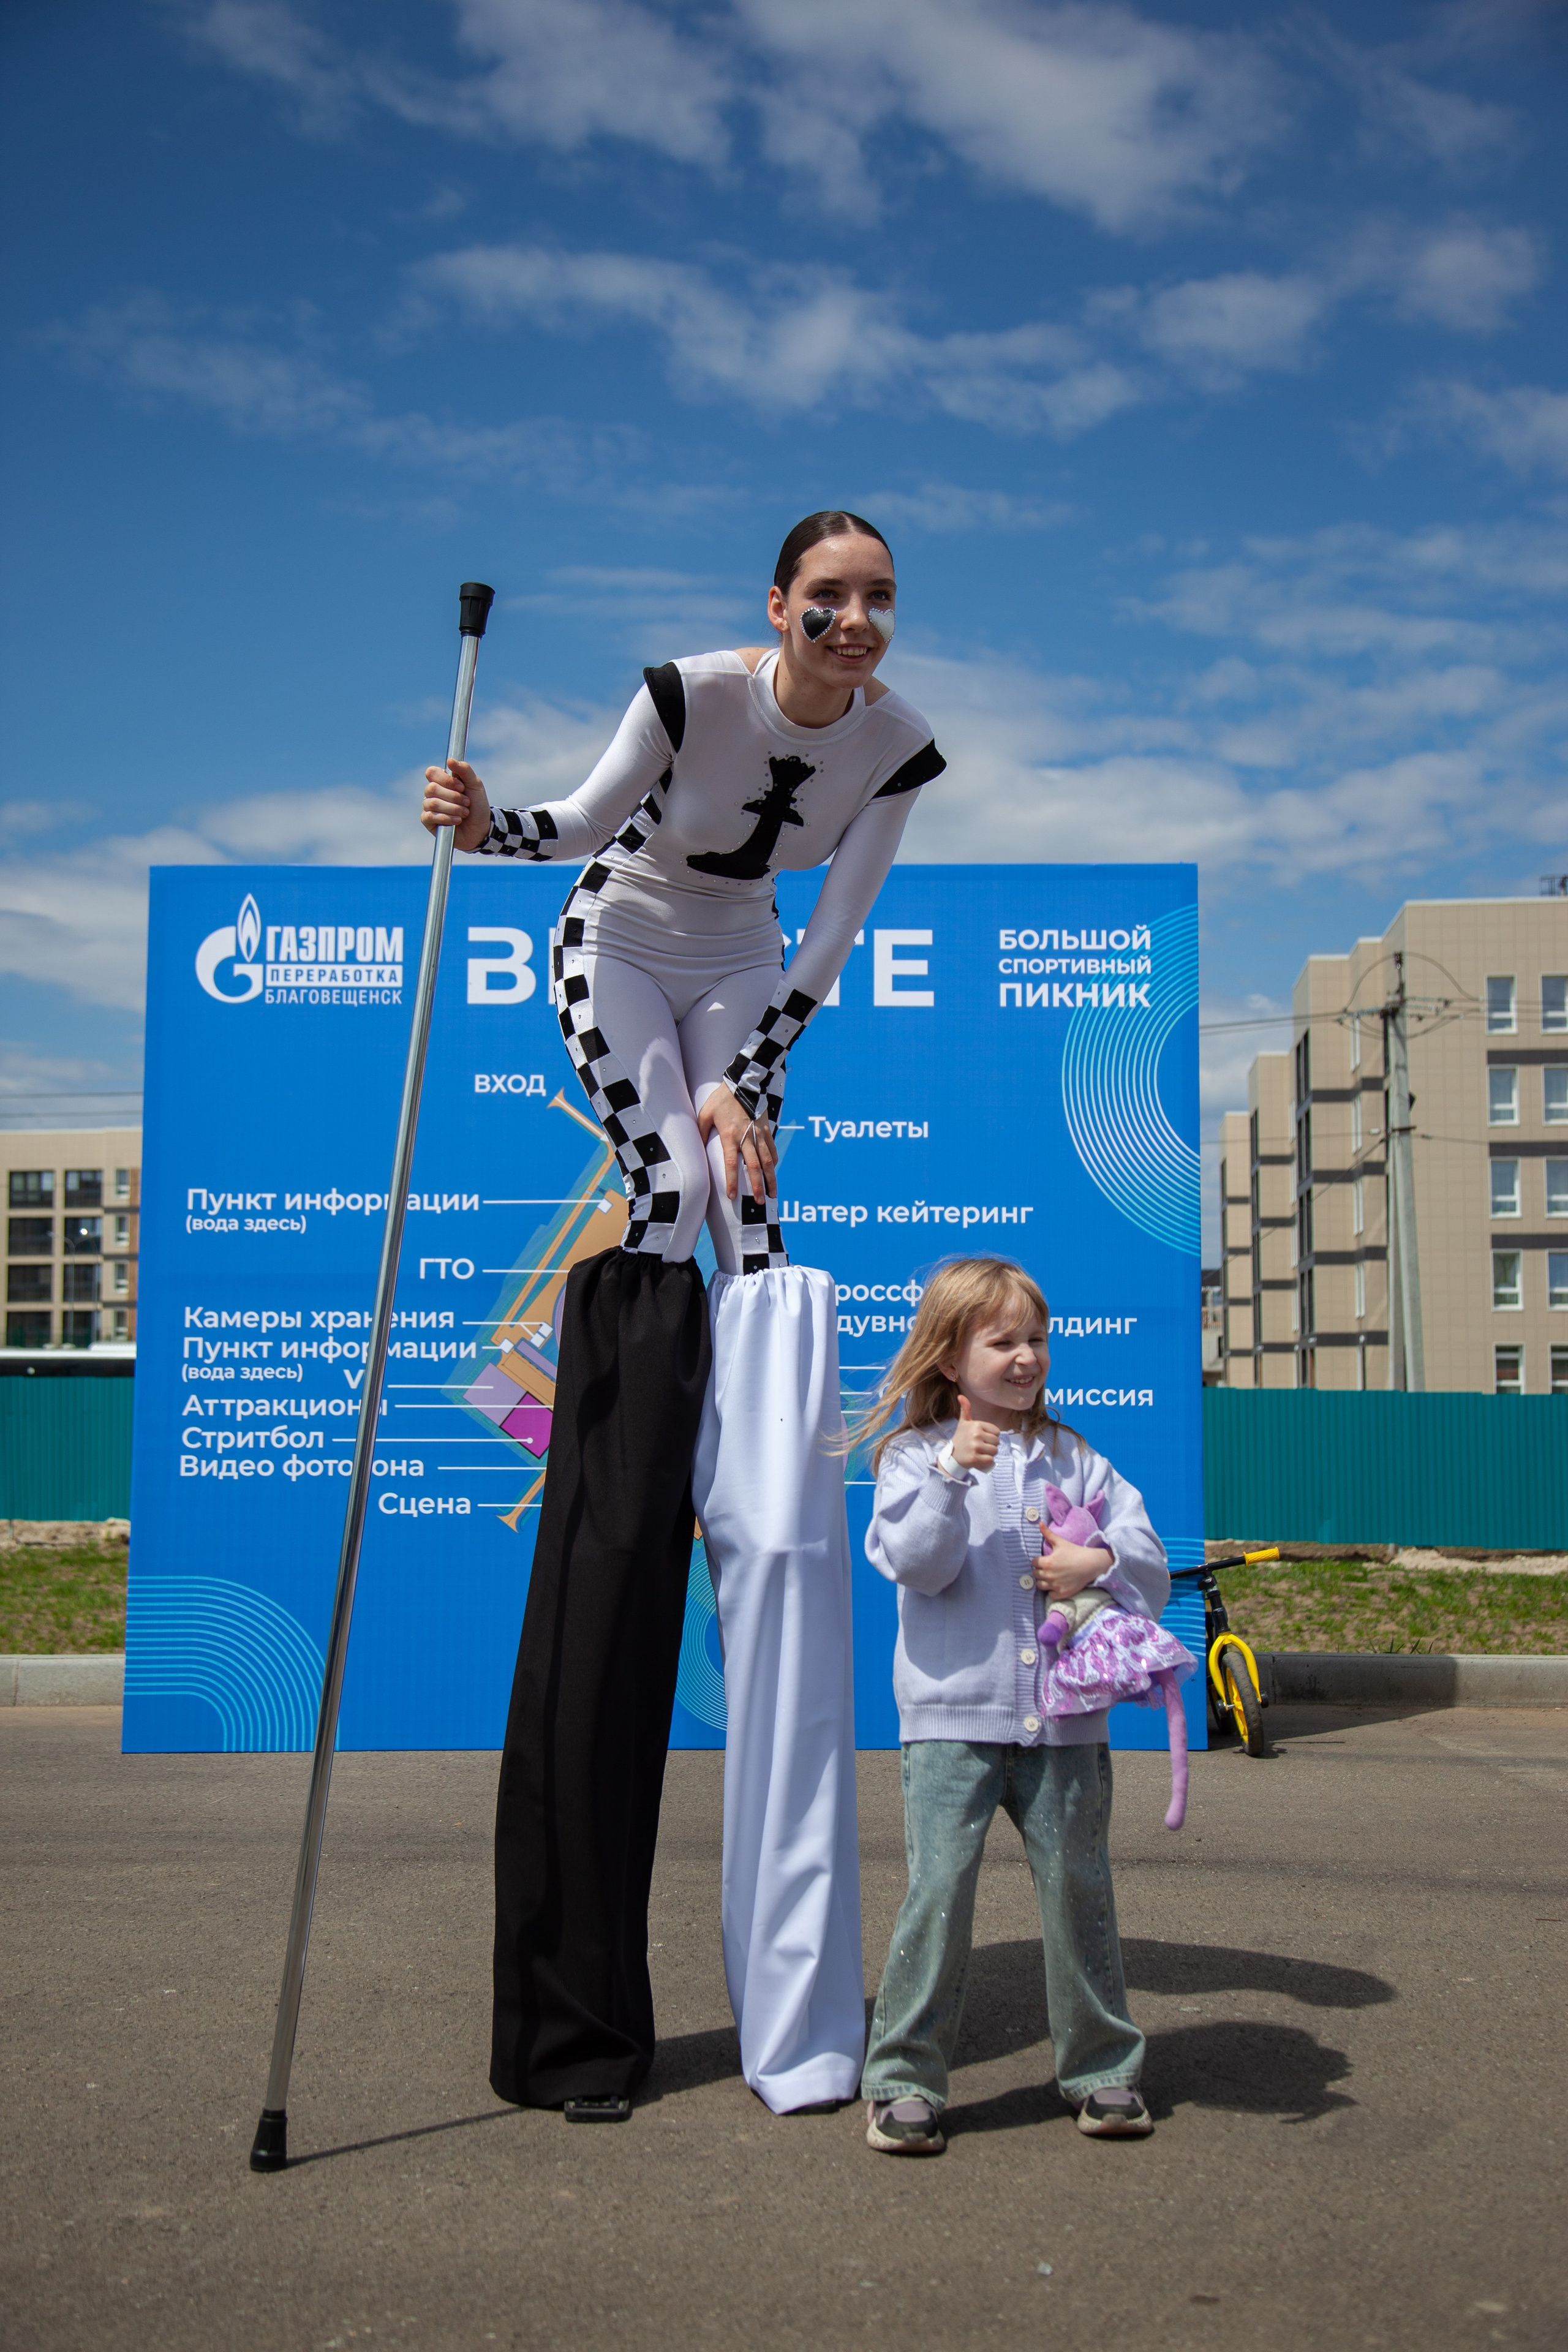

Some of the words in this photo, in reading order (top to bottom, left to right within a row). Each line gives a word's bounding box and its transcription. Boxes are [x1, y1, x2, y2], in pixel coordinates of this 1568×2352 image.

[266, 925, 404, 962] ГАЗПРОМ
[1000, 924, 1151, 950] БОЛЬШОЙ
[271, 968, 398, 982] ПЕРЕРАБОТКА
[998, 955, 1152, 974] СПОРТИВНЫЙ
[265, 989, 402, 1008] БЛАГОВЕЩЕНСК
[1000, 982, 1151, 1008] ПИКНИК
[475, 1074, 546, 1097] ВХОД
[809, 1116, 929, 1143] Туалеты
[187, 1188, 277, 1215] Пункт
[285, 1187, 480, 1216] инфорации
[779, 1200, 868, 1228] Шатер
[877, 1200, 1034, 1228] кейтеринг
[186, 1215, 239, 1234] (вода
[244, 1215, 307, 1234] здесь)
[420, 1257, 475, 1280] ГТО
[835, 1279, 924, 1307] россф
[184, 1306, 302, 1333] Камеры
[1048, 1317, 1137, 1337] лдинг
[183, 1336, 273, 1363] Пункт
[181, 1364, 235, 1382] (вода
[240, 1363, 303, 1382] здесь)
[1044, 1389, 1153, 1406] миссия
[182, 1425, 324, 1454] Стритбол
[179, 1455, 274, 1480] Видео
[282, 1453, 424, 1482] фотоона
[378, 1492, 471, 1518] Сцена
